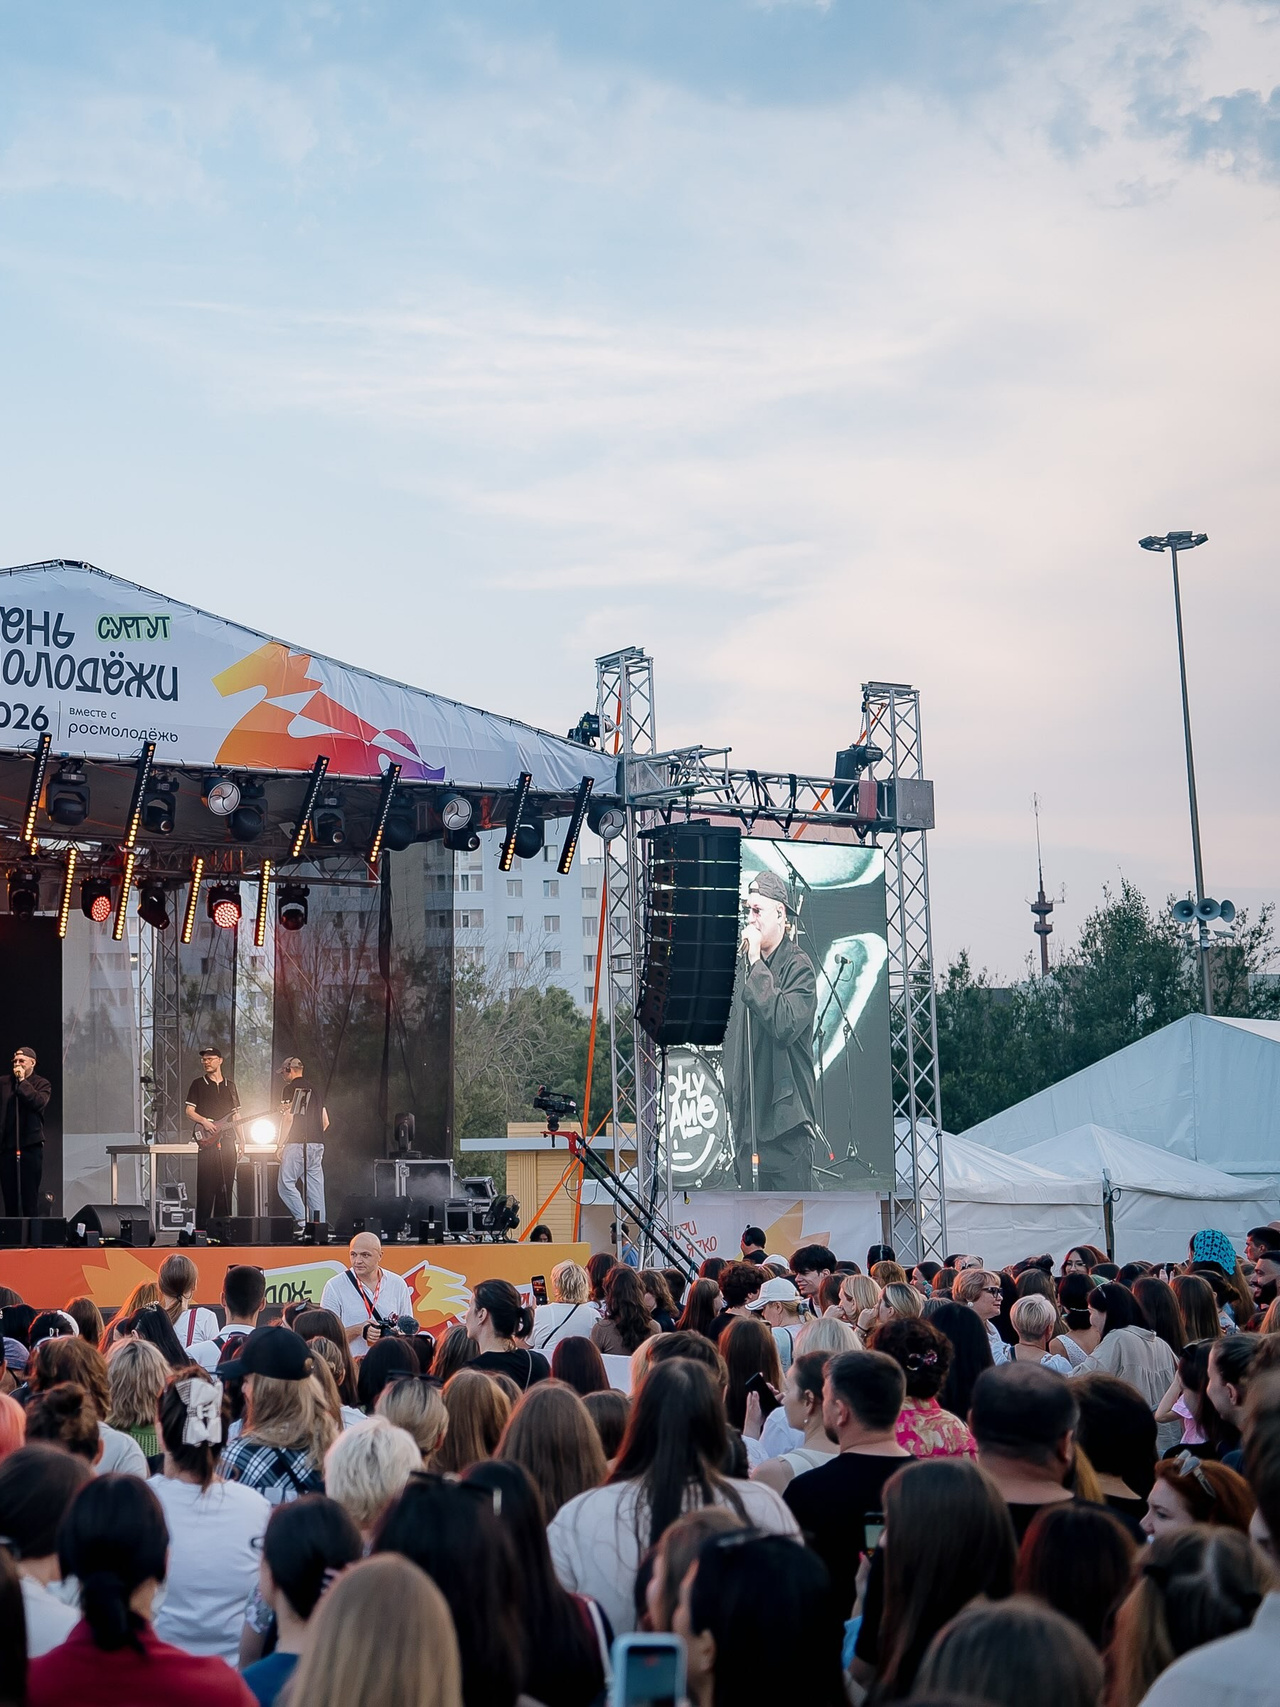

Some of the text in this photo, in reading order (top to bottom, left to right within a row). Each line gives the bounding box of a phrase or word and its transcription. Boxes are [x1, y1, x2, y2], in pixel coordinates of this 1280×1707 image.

[69, 707, 117, 720] вместе с
[68, 722, 179, 743] росмолодёжь
[666, 1065, 706, 1103] OLLY
